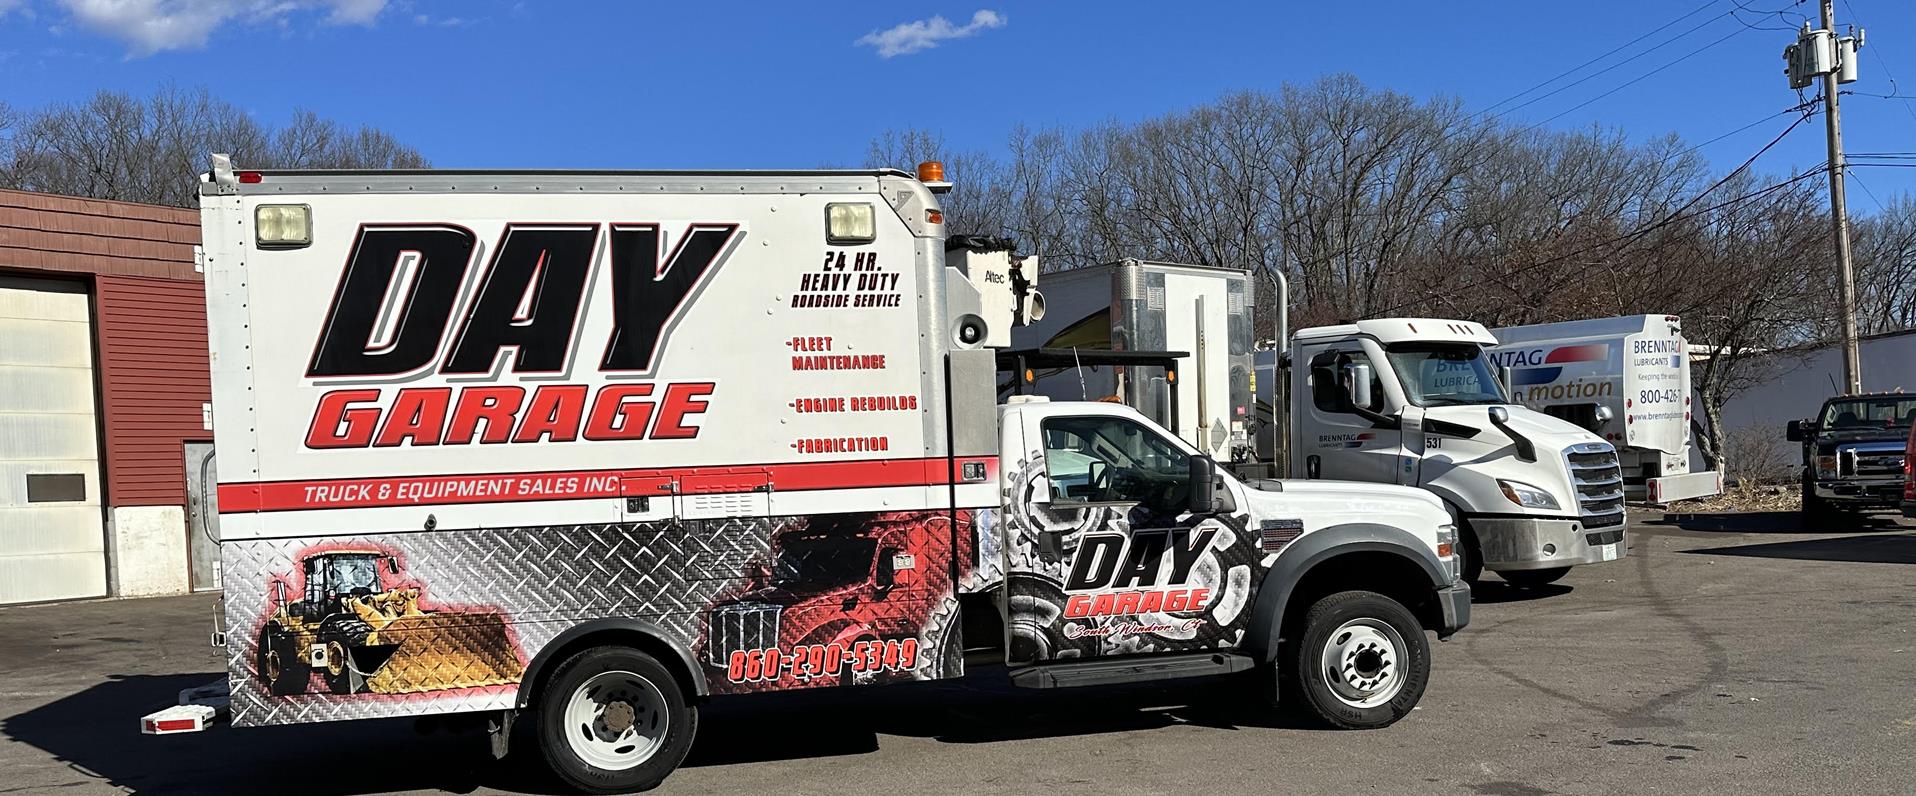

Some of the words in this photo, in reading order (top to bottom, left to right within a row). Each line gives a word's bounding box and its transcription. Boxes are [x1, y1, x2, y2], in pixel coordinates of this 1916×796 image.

[823, 251, 847, 272] 24
[854, 252, 882, 271] HR.
[800, 274, 852, 292] HEAVY
[857, 273, 899, 291] DUTY
[985, 270, 1005, 284] Altec
[304, 222, 743, 380] DAY
[791, 295, 849, 308] ROADSIDE
[853, 294, 901, 307] SERVICE
[792, 355, 886, 370] MAINTENANCE
[1634, 357, 1669, 366] LUBRICANTS
[1528, 378, 1613, 401] motion
[851, 396, 917, 411] REBUILDS
[304, 382, 716, 449] GARAGE
[1319, 433, 1356, 442] BRENNTAG
[1426, 438, 1442, 449] 531
[304, 485, 371, 503] TRUCK
[378, 484, 392, 500] &
[398, 479, 515, 502] EQUIPMENT
[517, 478, 579, 496] SALES
[583, 475, 627, 493] INC.
[1063, 528, 1222, 593] DAY
[1063, 589, 1210, 619] GARAGE
[1069, 624, 1110, 640] South
[728, 638, 919, 682] 860-290-5349
